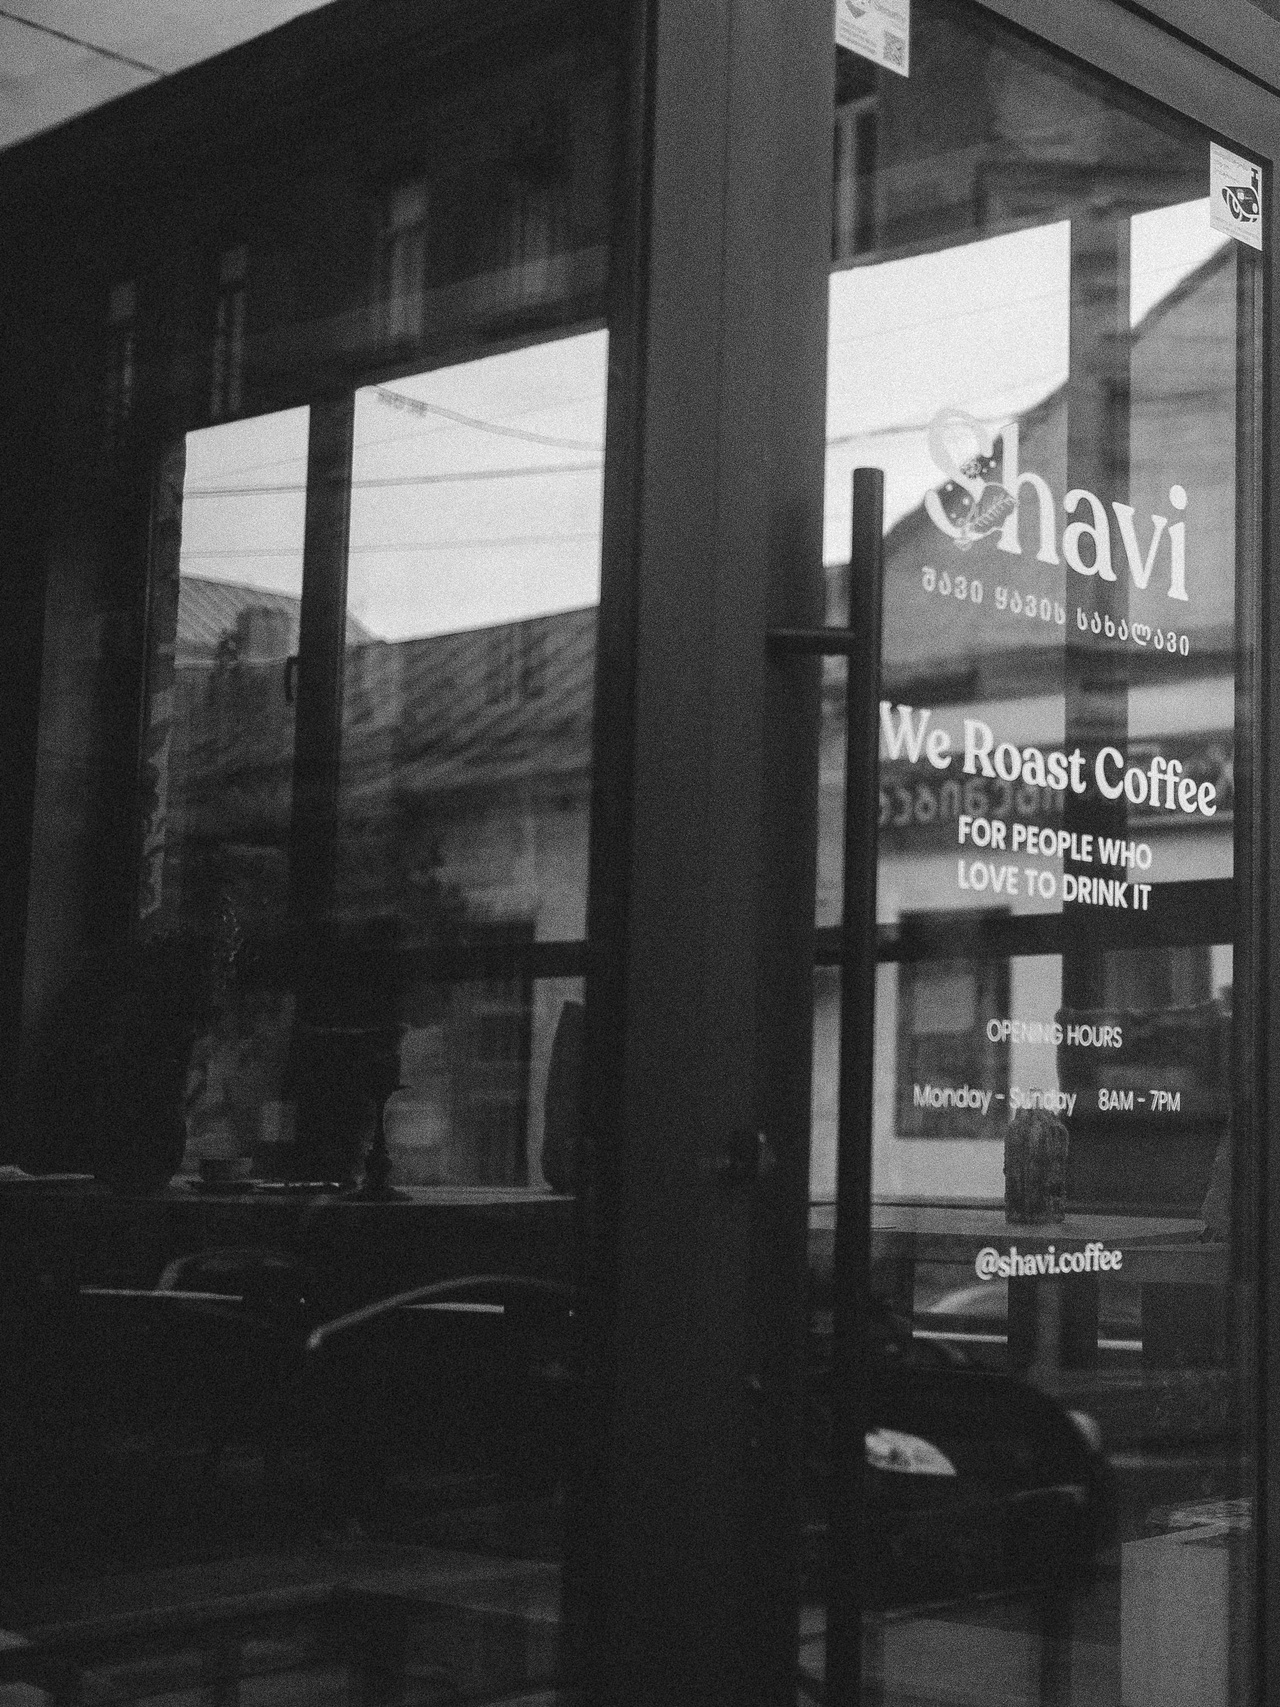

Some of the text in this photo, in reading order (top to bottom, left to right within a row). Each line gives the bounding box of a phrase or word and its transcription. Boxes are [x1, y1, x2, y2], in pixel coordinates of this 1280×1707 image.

[924, 408, 1188, 600] Shavi
[921, 565, 1190, 657] შავი ყავის სახალავი
[879, 700, 952, 769] We
[962, 718, 1087, 794] Roast
[1095, 746, 1217, 817] Coffee
[957, 814, 1152, 870] FOR PEOPLE WHO
[957, 859, 1152, 911] LOVE TO DRINK IT
[986, 1018, 1123, 1048] OPENING HOURS
[913, 1084, 992, 1115] Monday
[1009, 1087, 1077, 1117] Sunday
[1098, 1088, 1134, 1111] 8AM
[1149, 1089, 1181, 1112] 7PM
[975, 1242, 1123, 1281] @shavi.coffee
